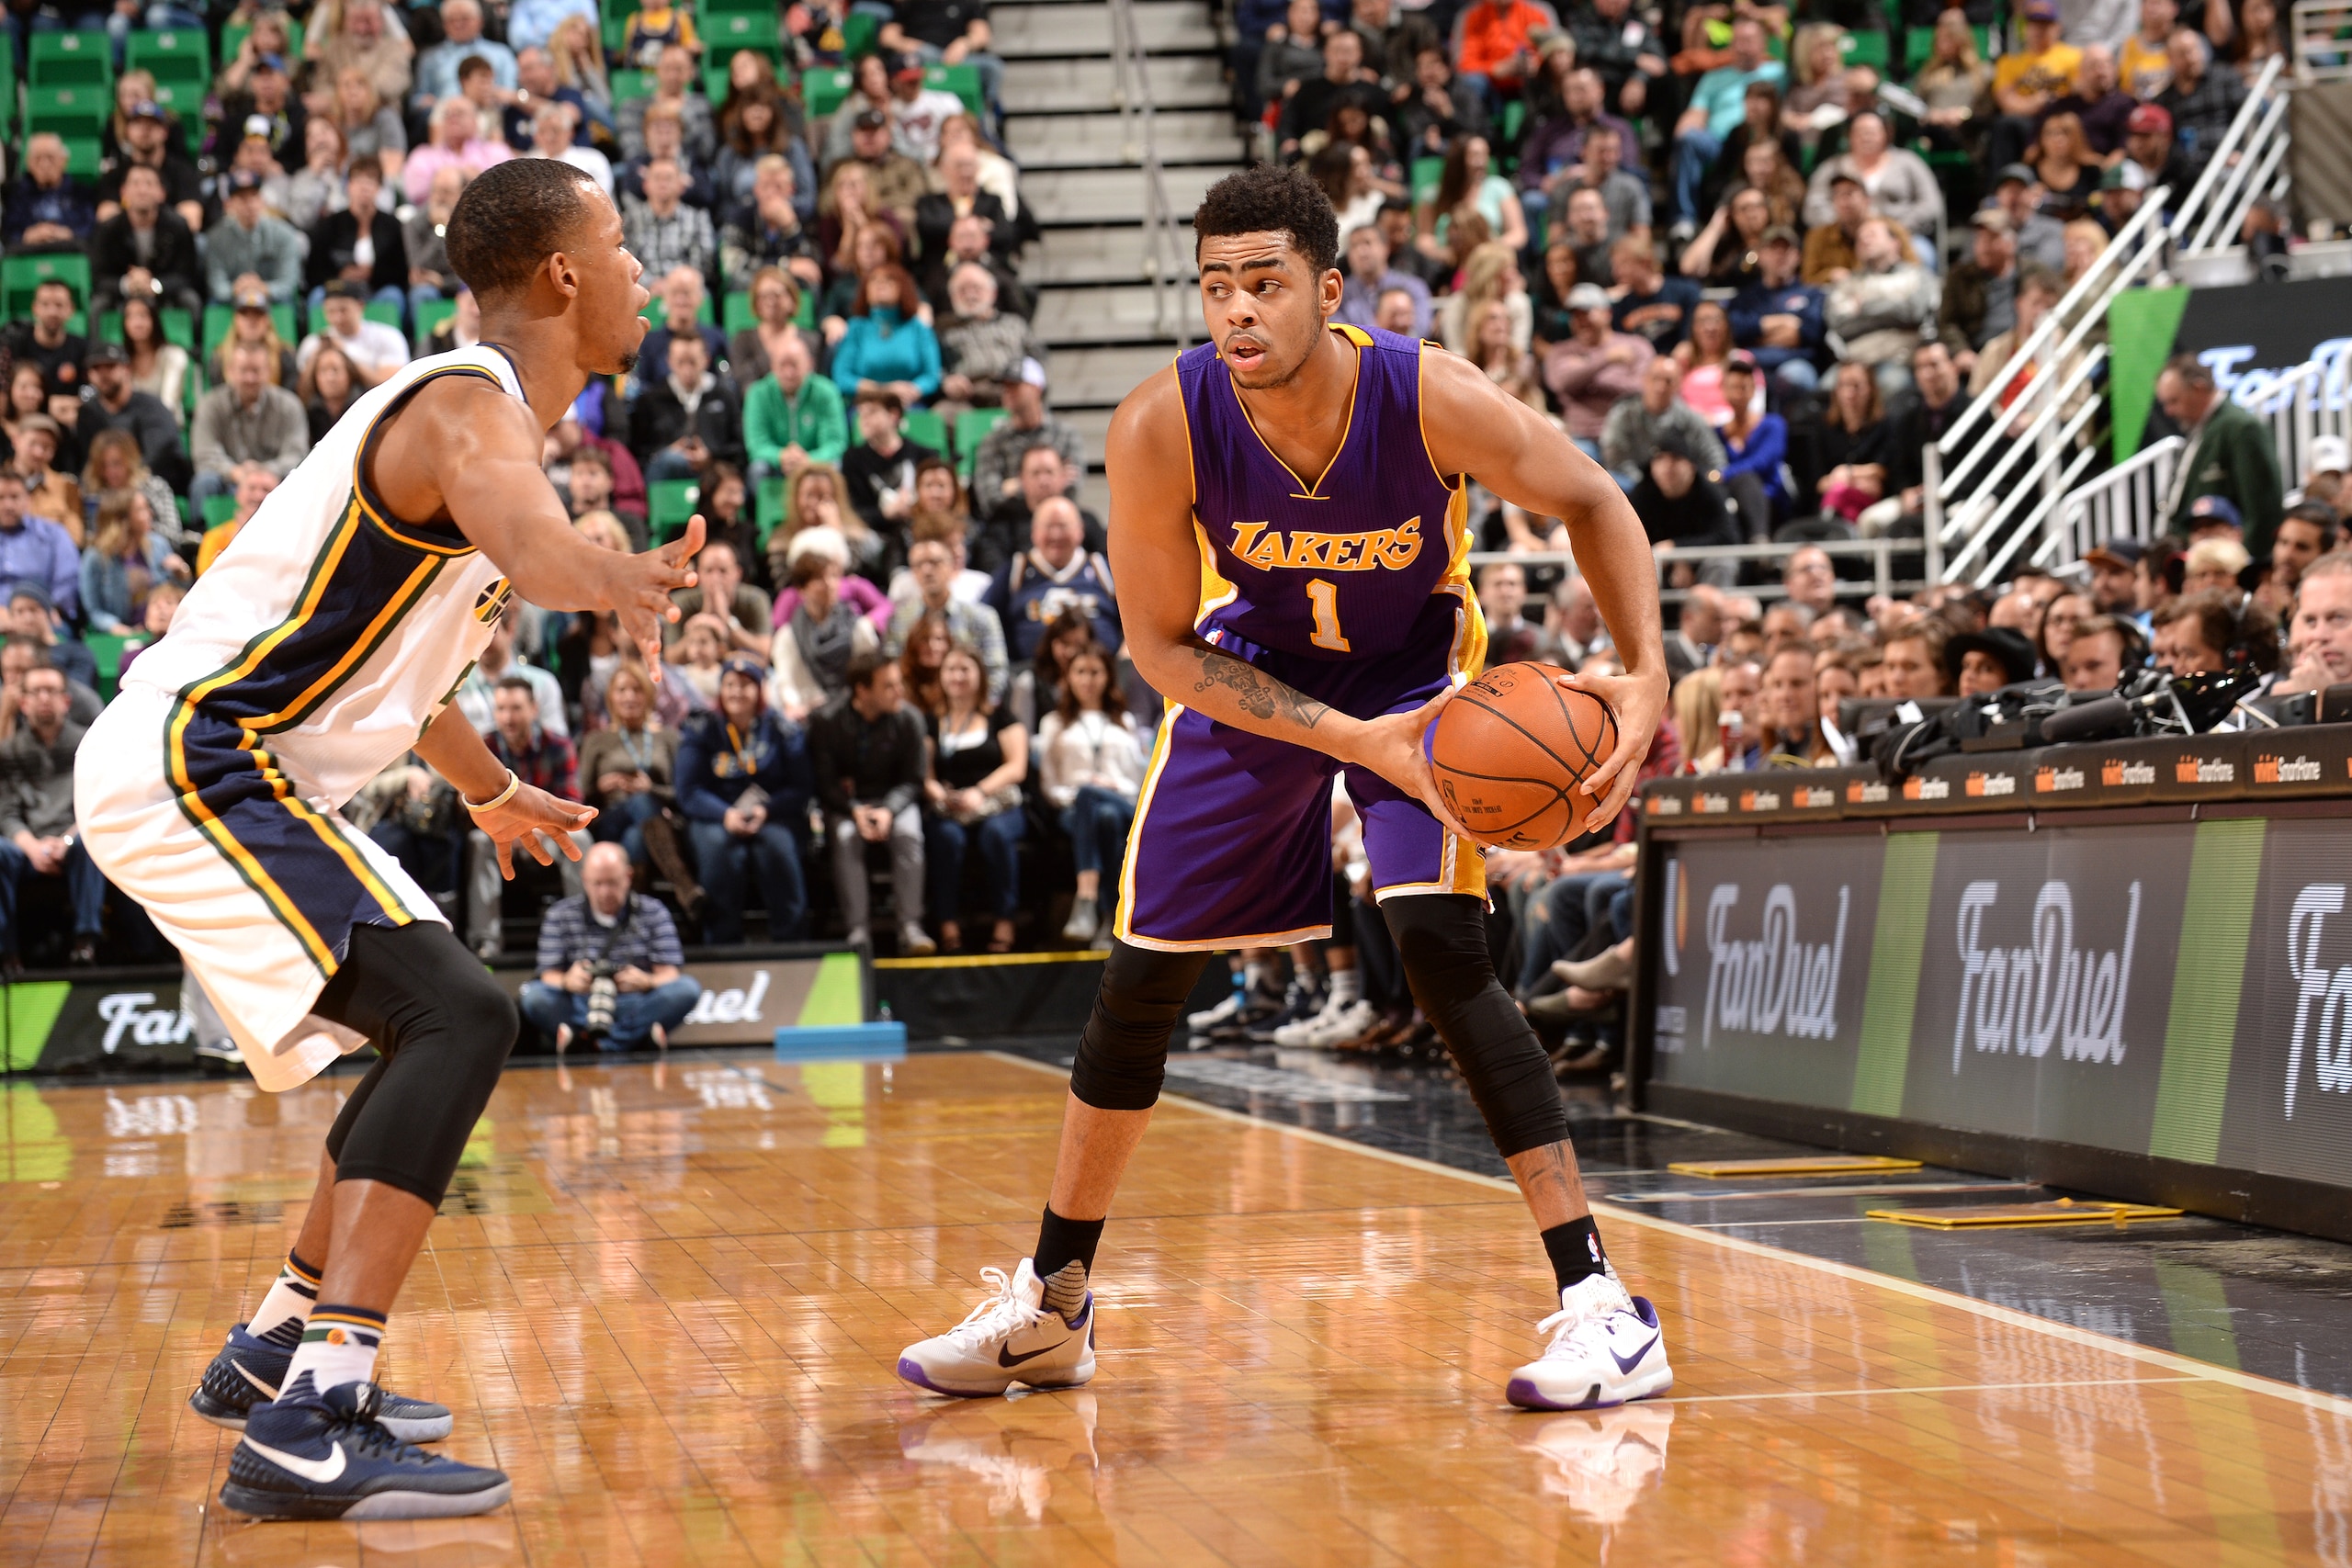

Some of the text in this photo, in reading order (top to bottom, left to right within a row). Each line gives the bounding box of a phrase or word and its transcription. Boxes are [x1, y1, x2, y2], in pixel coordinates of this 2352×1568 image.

[1227, 515, 1423, 571] LAKERS
[1306, 578, 1351, 653] 1
[1193, 671, 1225, 693] GOD
[1232, 674, 1255, 692] MY
[1238, 686, 1271, 711] STEP
[1702, 883, 1849, 1051] FanDuel
[1952, 878, 2142, 1077] FanDuel
